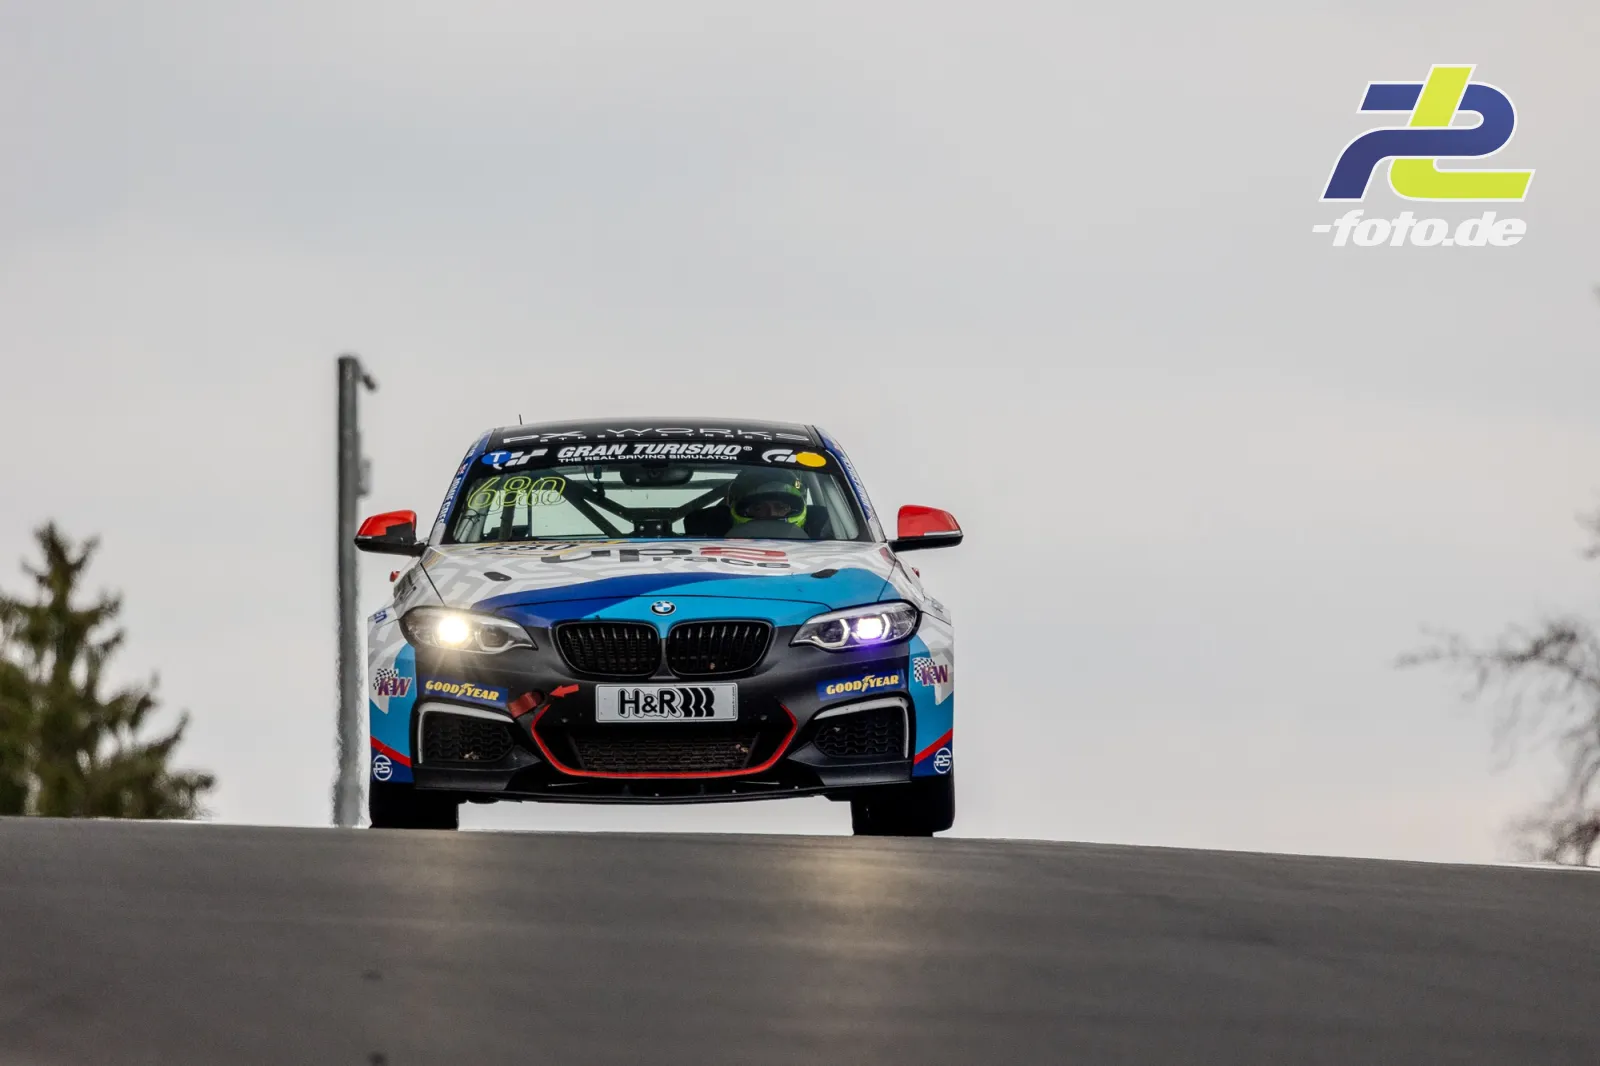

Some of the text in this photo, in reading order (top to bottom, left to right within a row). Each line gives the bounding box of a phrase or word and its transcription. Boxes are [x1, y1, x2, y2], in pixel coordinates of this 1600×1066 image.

[606, 427, 810, 441] WORKS
[557, 444, 628, 459] GRAN
[467, 475, 566, 509] 680
[920, 664, 949, 686] KW
[377, 676, 412, 697] KW
[618, 688, 682, 718] H&R
